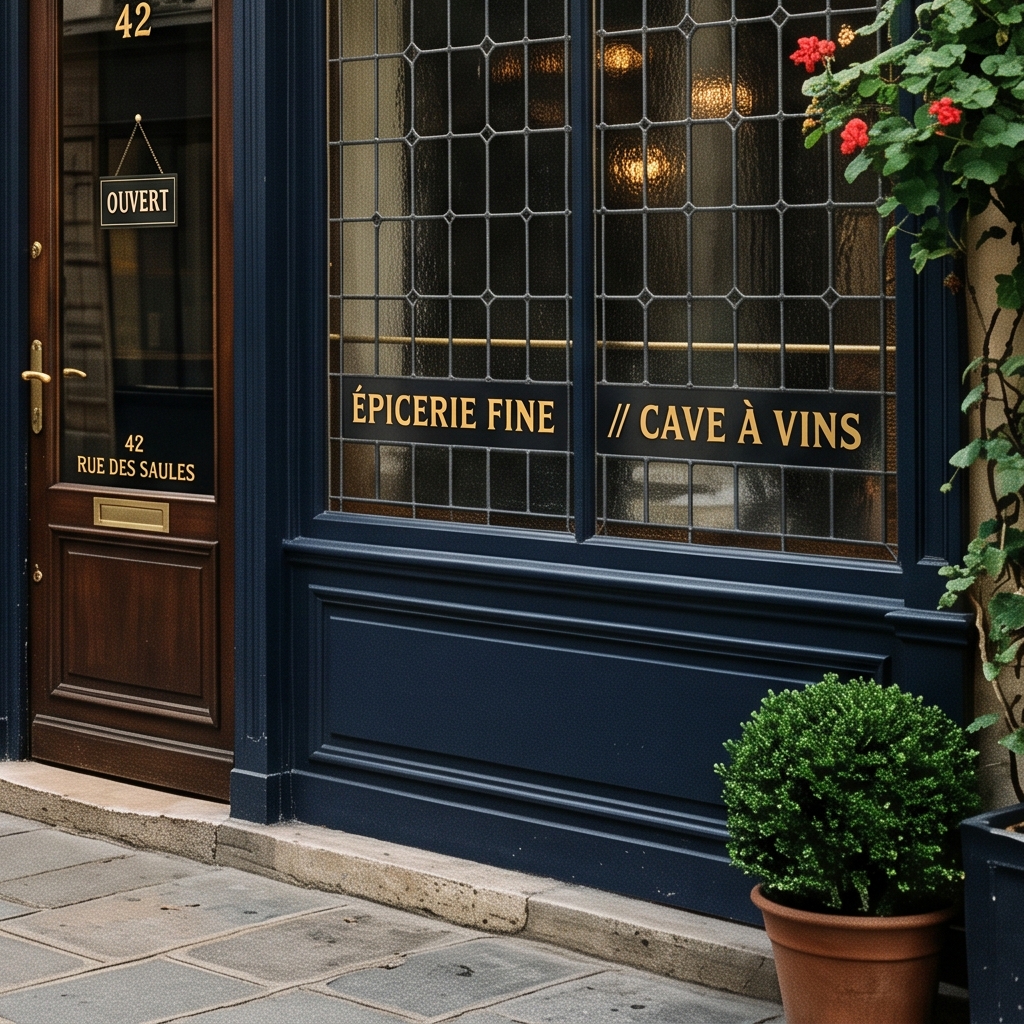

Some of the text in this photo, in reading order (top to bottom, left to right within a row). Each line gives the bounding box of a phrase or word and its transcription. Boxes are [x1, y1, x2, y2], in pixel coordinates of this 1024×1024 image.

[114, 1, 152, 39] 42
[106, 188, 169, 214] OUVERT
[352, 384, 555, 434] ÉPICERIE FINE
[640, 404, 726, 443] CAVE
[737, 399, 763, 445] À
[773, 409, 862, 451] VINS
[124, 434, 144, 453] 42
[77, 455, 195, 482] RUE DES SAULES
